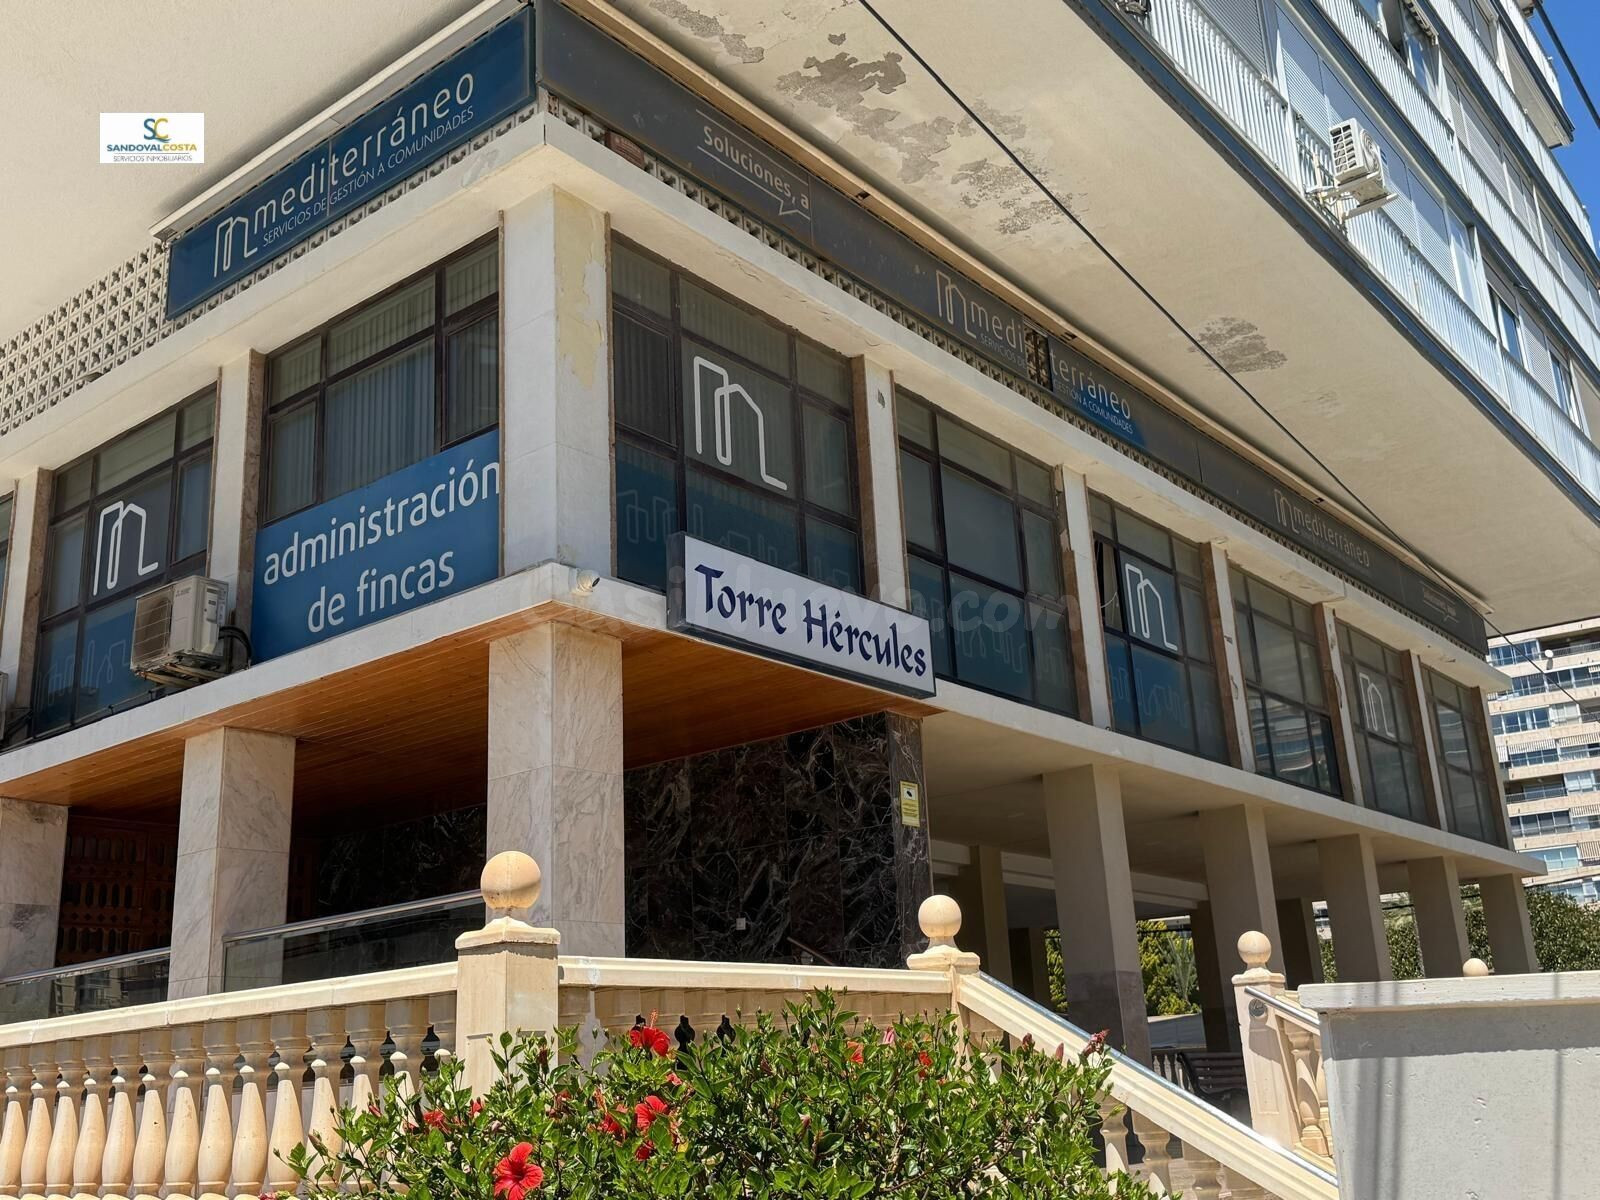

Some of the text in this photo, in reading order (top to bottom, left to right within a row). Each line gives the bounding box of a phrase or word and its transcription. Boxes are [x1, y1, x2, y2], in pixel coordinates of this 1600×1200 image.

[253, 73, 474, 235] mediterráneo
[263, 105, 475, 247] SERVICIOS DE GESTIÓN A COMUNIDADES
[703, 125, 809, 210] Soluciones, a
[970, 300, 1132, 420] medi terráneo
[980, 333, 1017, 362] SERVICIOS
[1082, 397, 1089, 409] A
[1088, 399, 1134, 435] COMUNIDADES
[263, 458, 500, 586] administración
[1293, 508, 1371, 568] mediterráneo
[307, 551, 455, 634] de fincas
[694, 563, 927, 677] Torre Hércules
